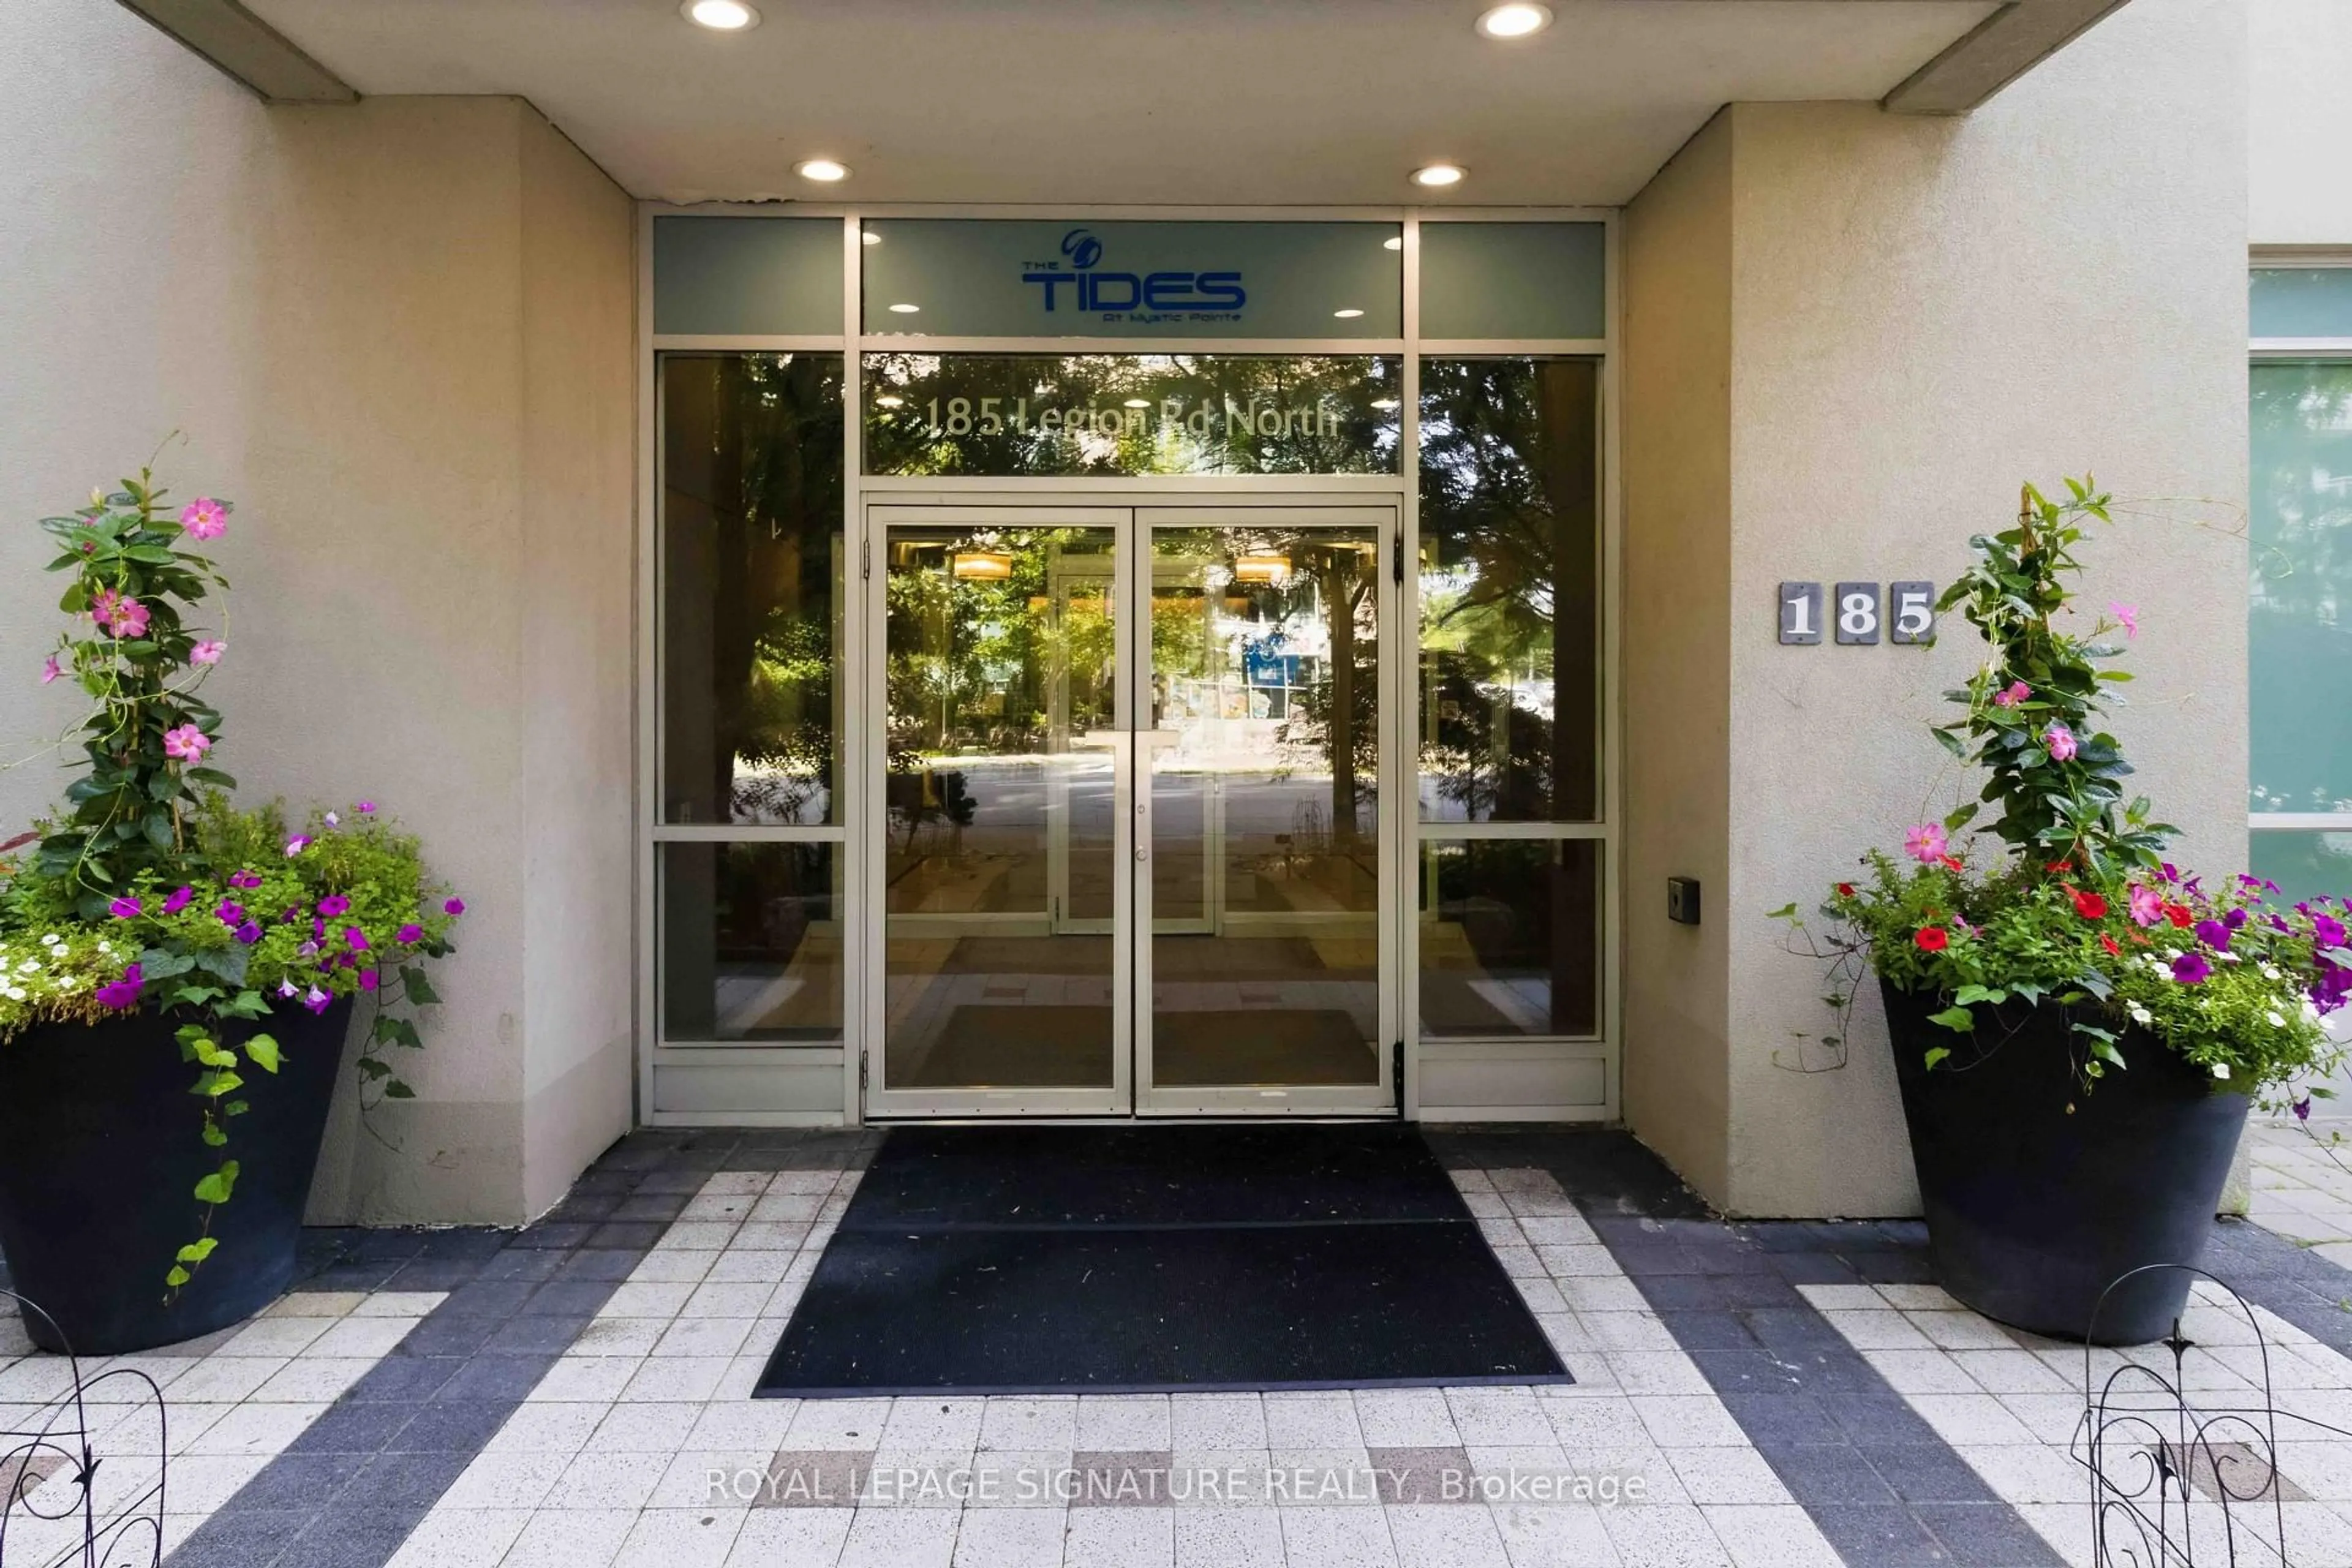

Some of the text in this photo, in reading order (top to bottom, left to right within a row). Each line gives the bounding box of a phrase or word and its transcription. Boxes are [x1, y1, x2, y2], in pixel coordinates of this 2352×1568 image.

[1022, 273, 1246, 311] TIDES
[1130, 313, 1183, 323] Mystic
[927, 398, 1338, 442] 185 Legion Rd North
[1787, 592, 1932, 635] 185
